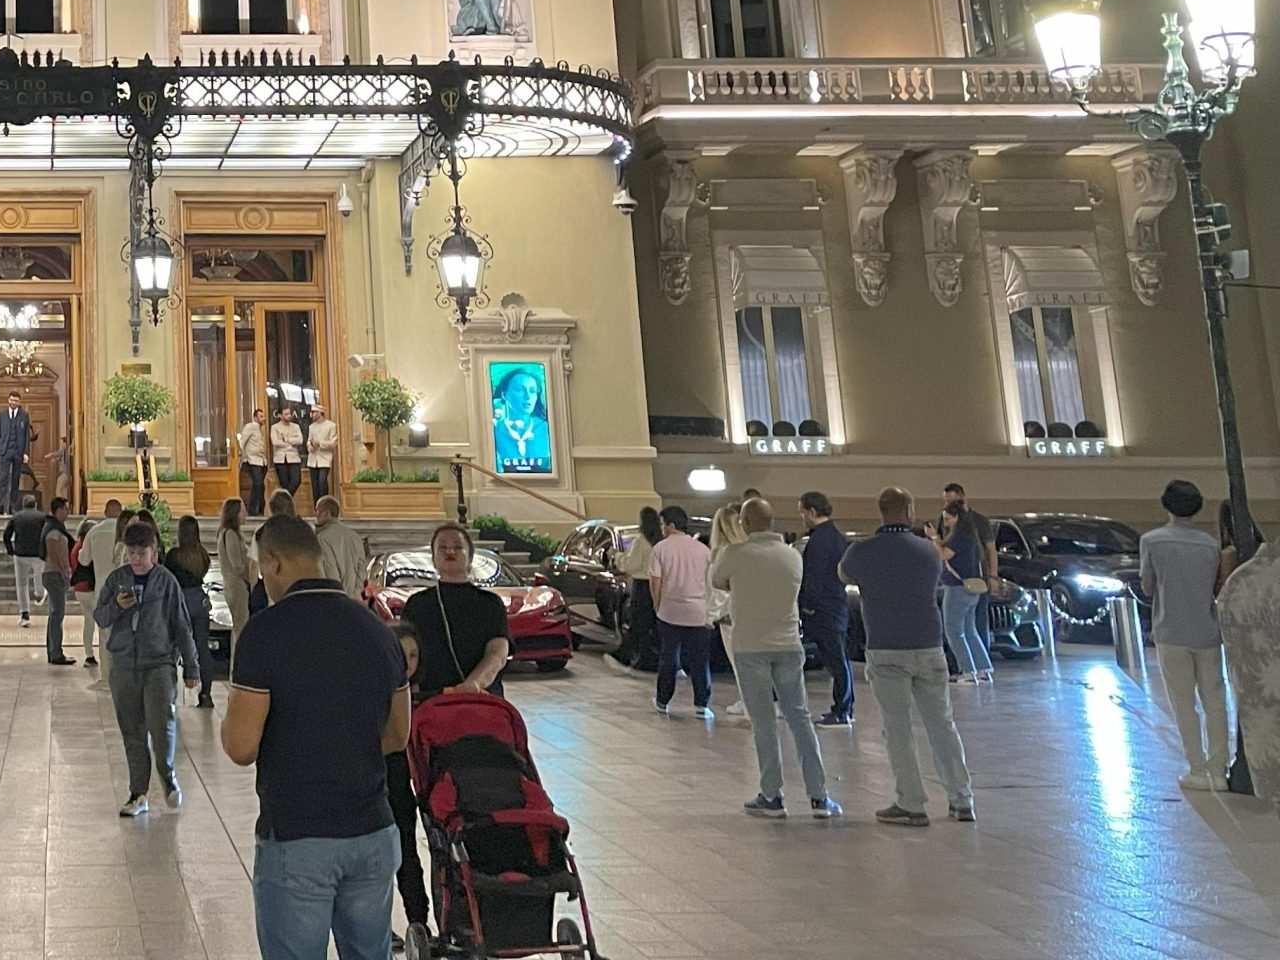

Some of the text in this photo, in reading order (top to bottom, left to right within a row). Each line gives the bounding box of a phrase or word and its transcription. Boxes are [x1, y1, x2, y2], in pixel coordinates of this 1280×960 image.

[755, 292, 824, 304] GRAFF
[1035, 292, 1104, 304] GRAFF
[273, 408, 312, 418] GAF
[755, 439, 826, 453] GRAFF
[1035, 440, 1105, 455] GRAFF
[503, 457, 543, 466] GRAFF
